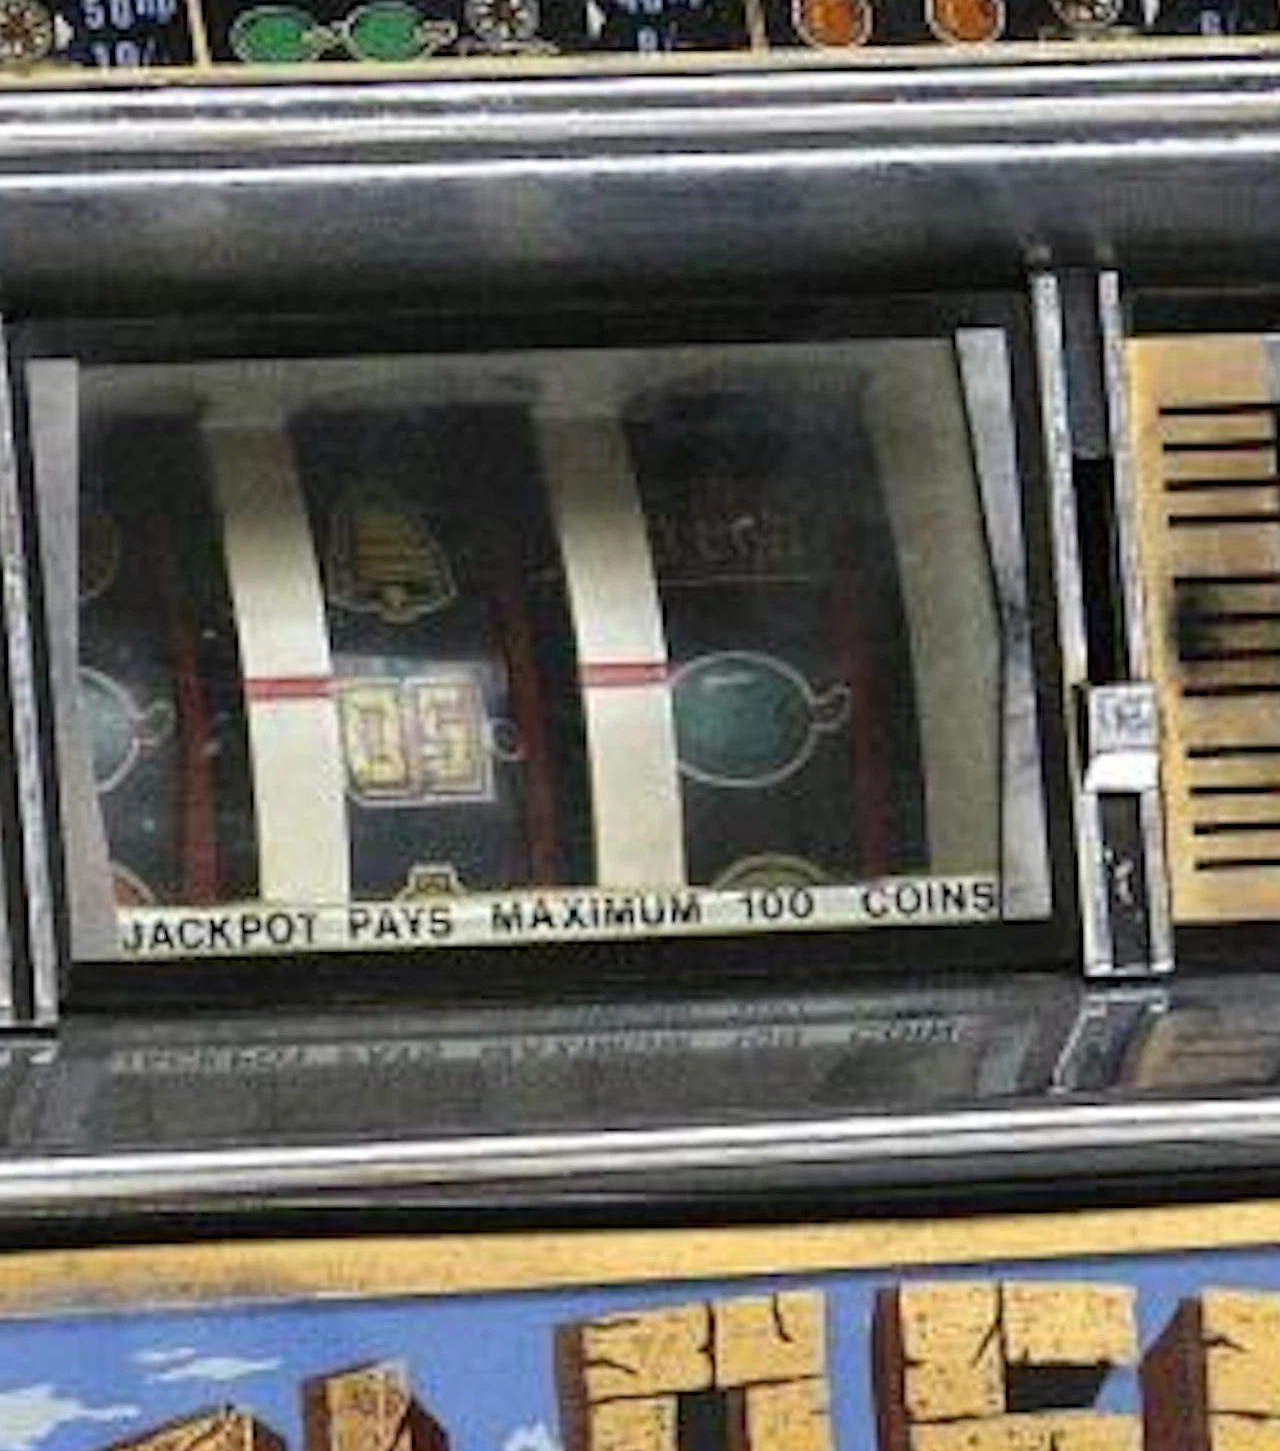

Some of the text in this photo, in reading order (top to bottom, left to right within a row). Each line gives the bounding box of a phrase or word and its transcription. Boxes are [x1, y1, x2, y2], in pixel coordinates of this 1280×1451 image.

[122, 881, 997, 953] JACKPOT PAYS MAXIMUM 100 COINS
